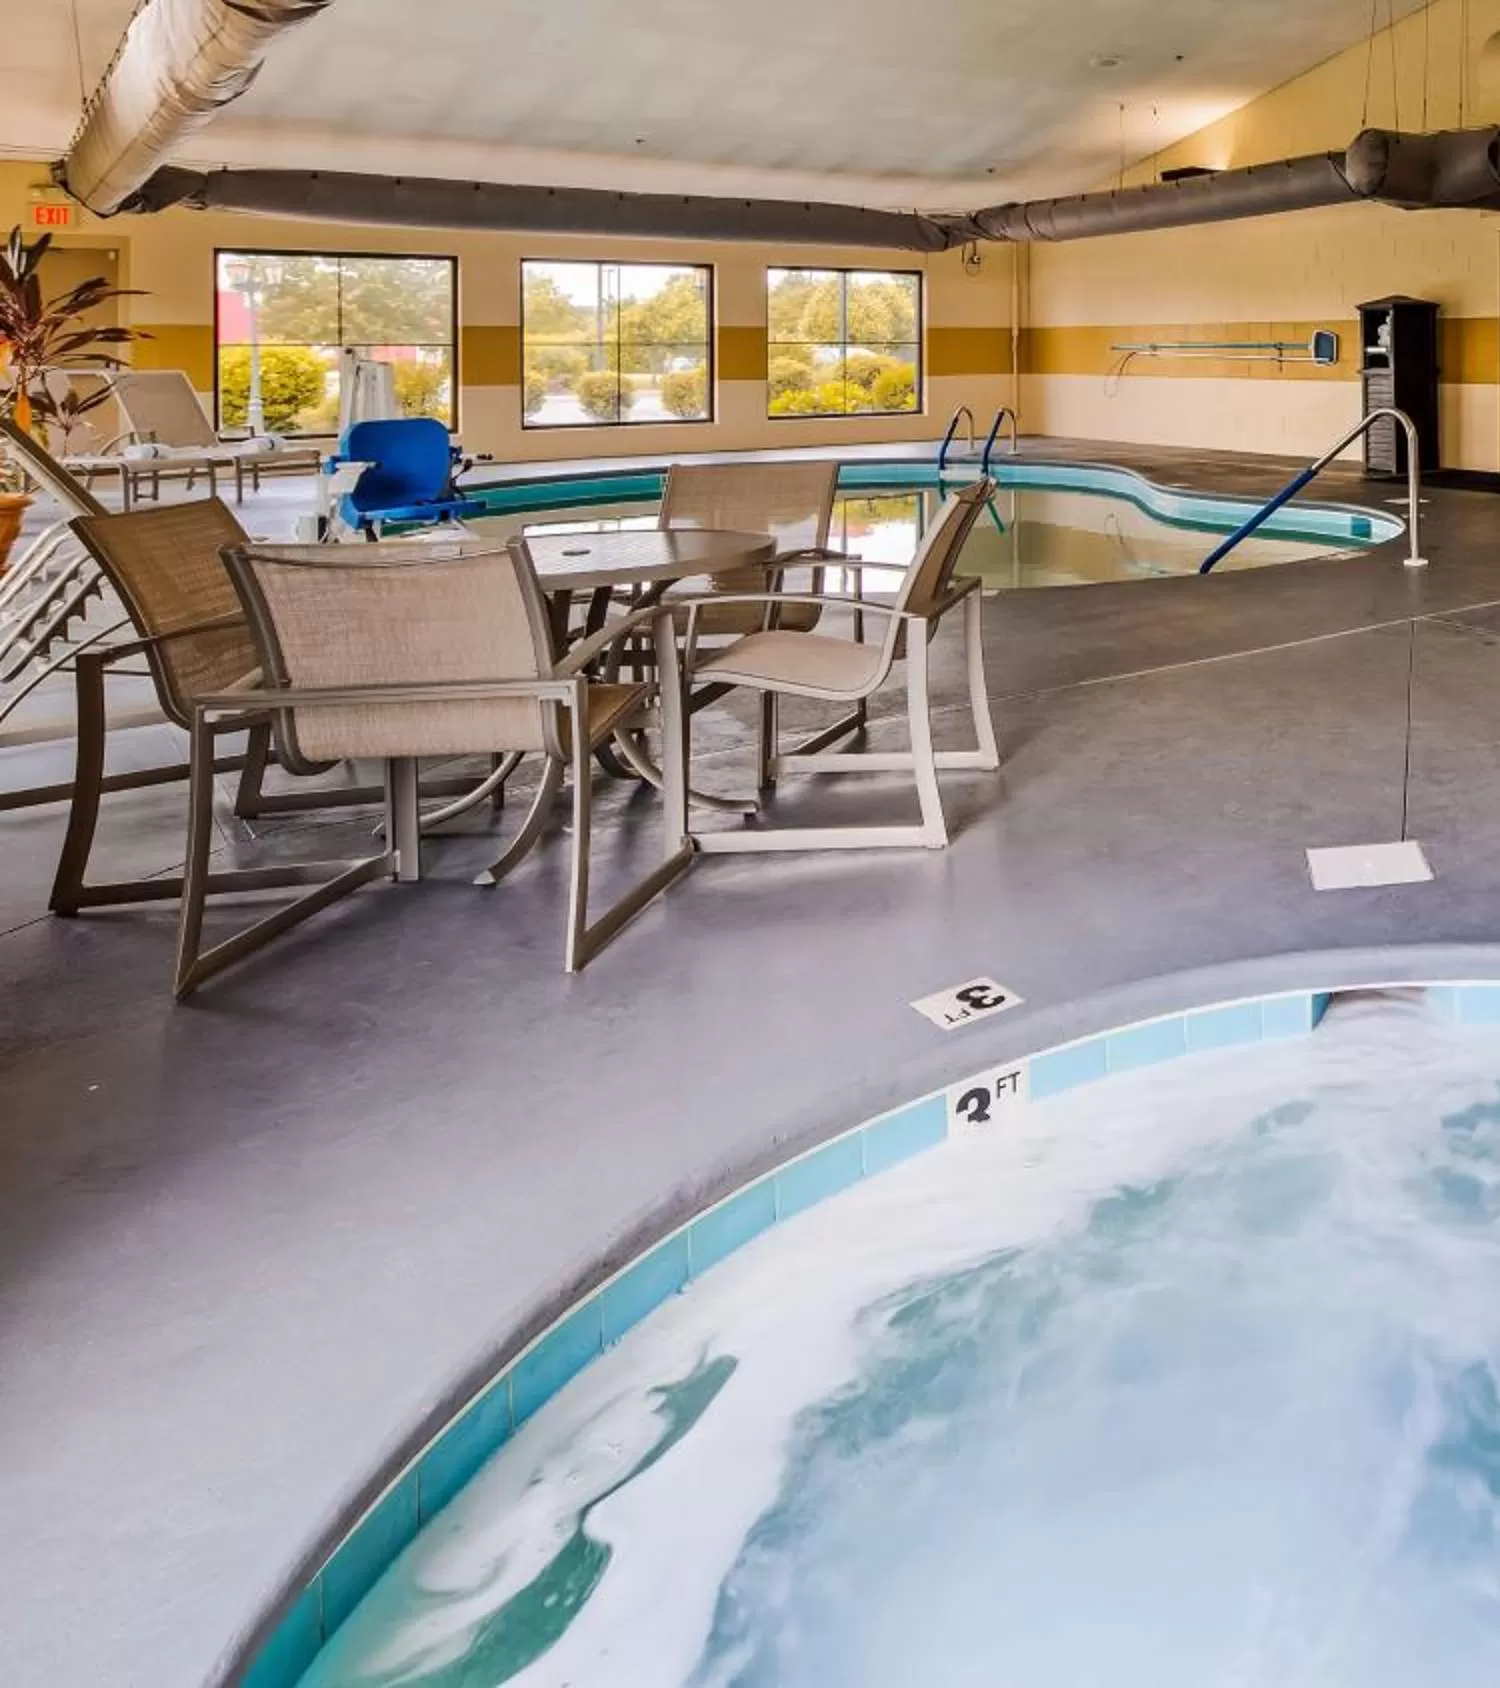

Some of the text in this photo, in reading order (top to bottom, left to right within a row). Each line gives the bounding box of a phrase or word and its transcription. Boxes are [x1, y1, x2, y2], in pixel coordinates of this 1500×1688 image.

[34, 207, 69, 225] EXIT
[955, 985, 1005, 1010] 3
[996, 1071, 1021, 1099] FT
